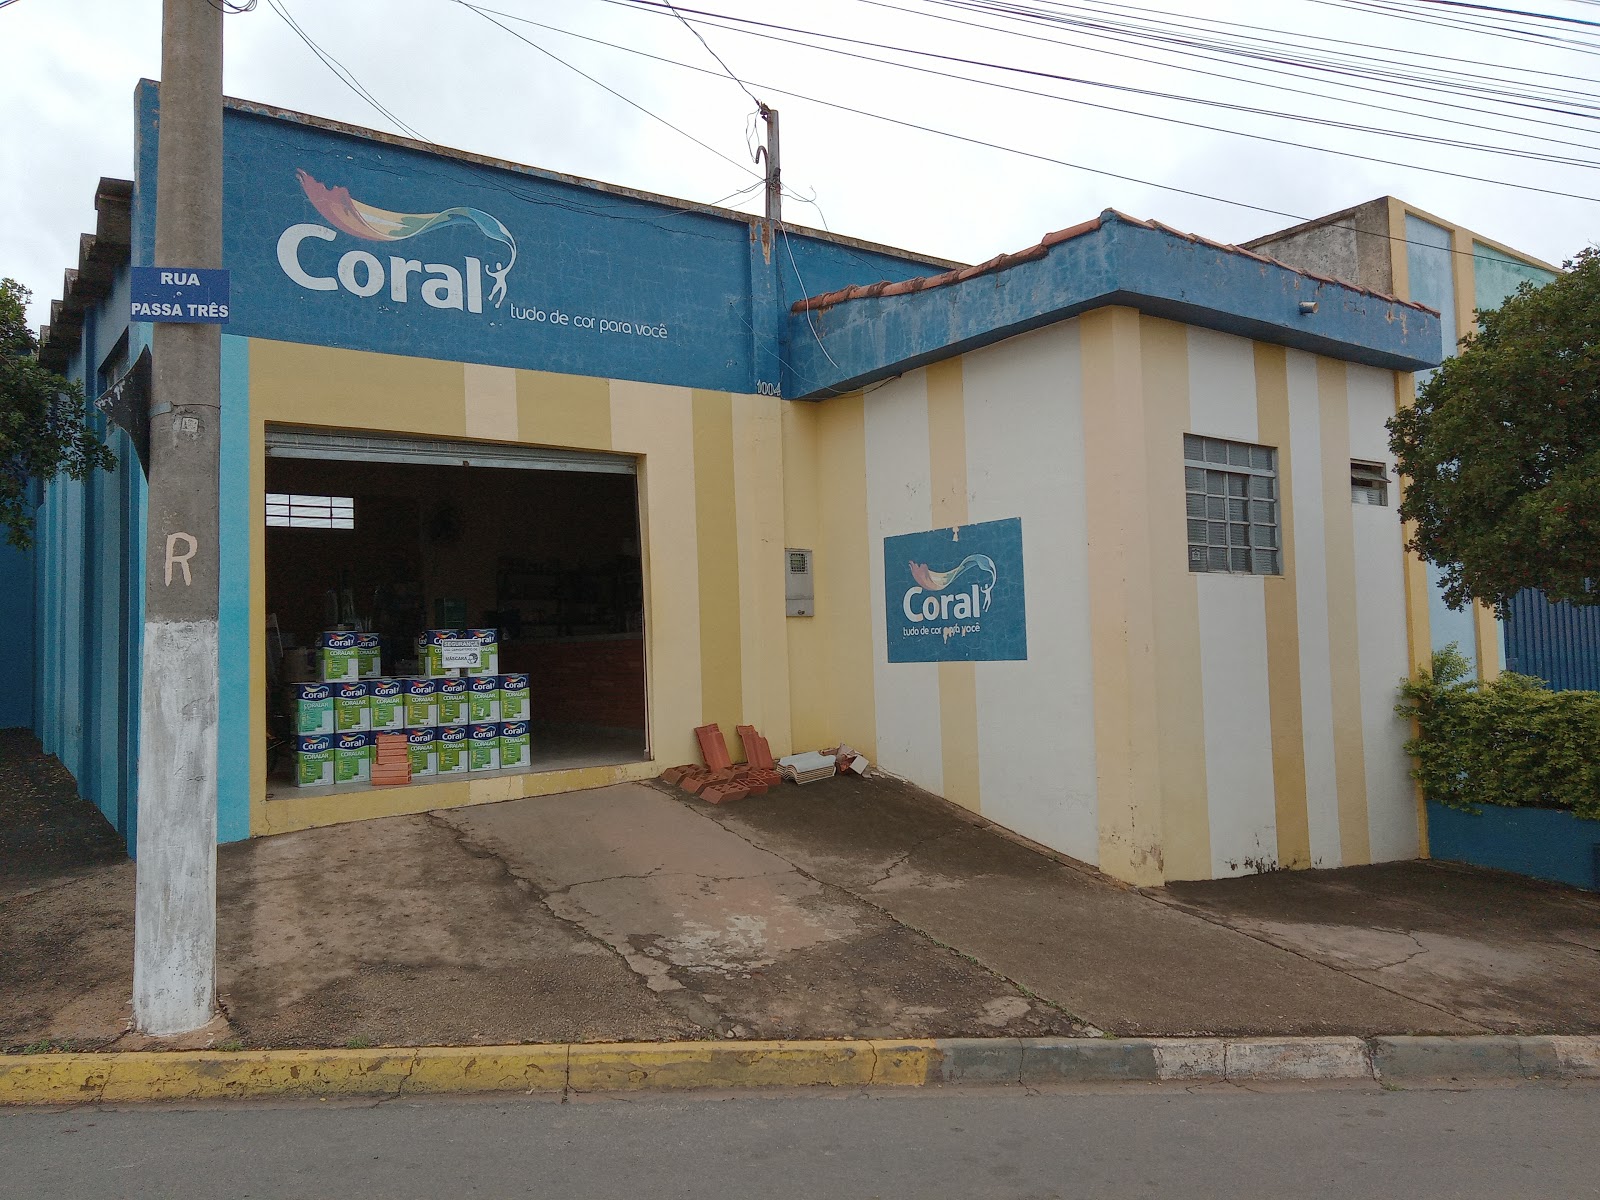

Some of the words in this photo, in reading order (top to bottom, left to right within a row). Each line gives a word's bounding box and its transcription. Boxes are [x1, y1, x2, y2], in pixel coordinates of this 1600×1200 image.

[276, 223, 482, 313] Coral
[160, 272, 200, 286] RUA
[131, 302, 183, 316] PASSA
[187, 302, 229, 318] TRÊS
[510, 303, 546, 322] tudo
[550, 309, 569, 326] de
[573, 315, 596, 329] cor
[600, 319, 632, 334] para
[635, 323, 668, 339] você
[757, 379, 781, 396] 1004
[164, 532, 198, 587] R
[903, 584, 980, 622] Coral
[903, 626, 919, 636] tudo
[920, 625, 929, 635] de
[931, 626, 941, 635] cor
[328, 639, 351, 647] Coral
[472, 683, 493, 691] Coral
[504, 681, 523, 689] Coral
[340, 689, 362, 697] Coral
[375, 687, 397, 695] Coral
[410, 686, 431, 694] Coral
[302, 691, 325, 699] Coral
[473, 730, 493, 739] Coral
[503, 727, 523, 735] Coral
[409, 734, 430, 743] Coral
[442, 732, 462, 740] Coral
[302, 742, 325, 751] Coral
[339, 740, 361, 748] Coral
